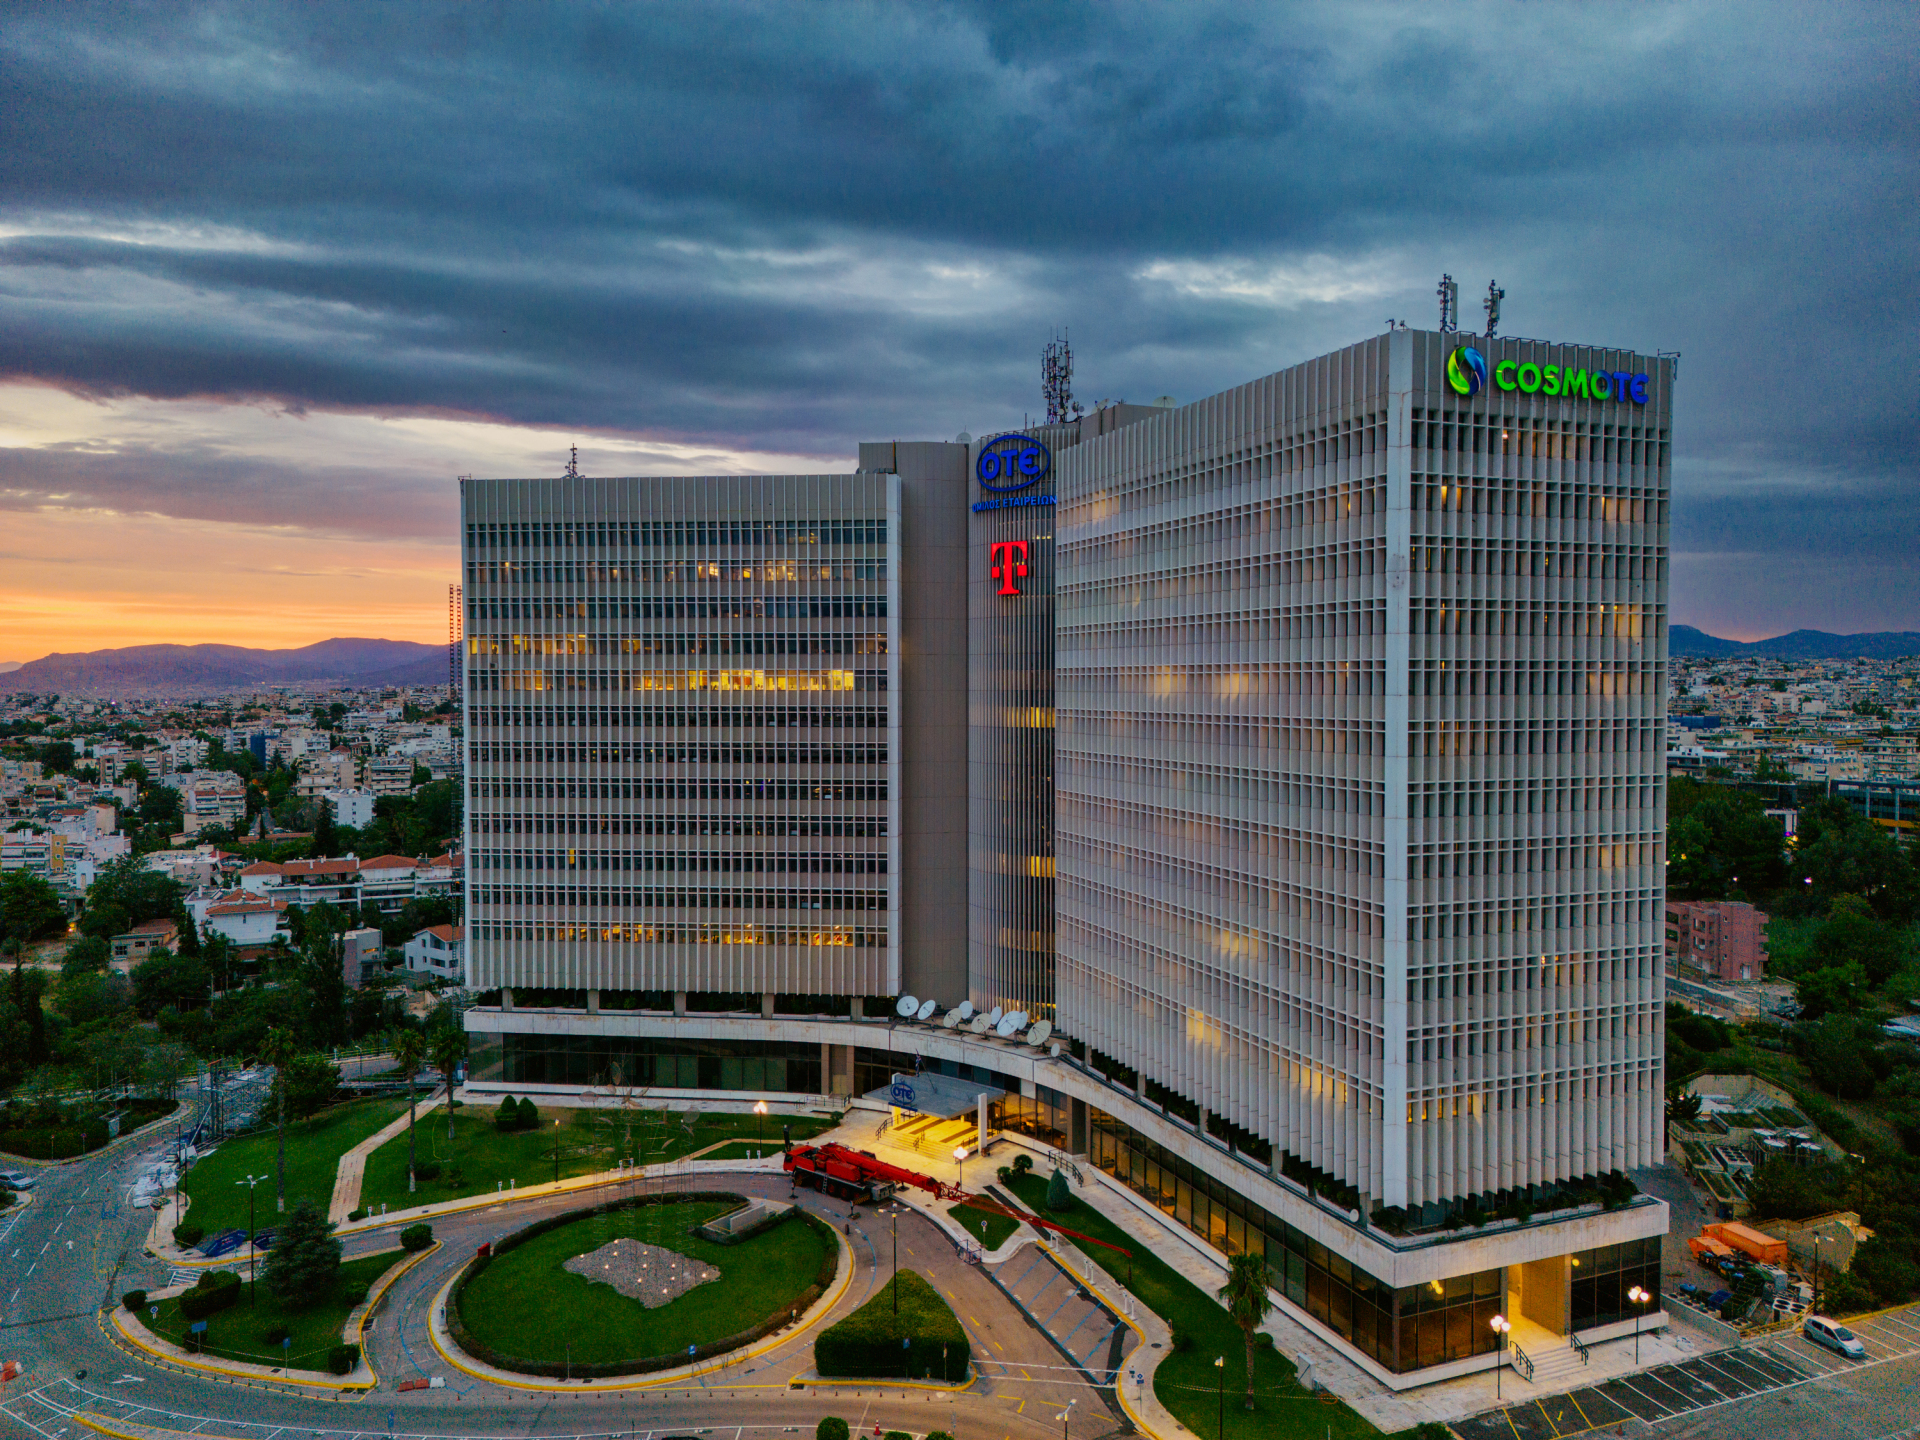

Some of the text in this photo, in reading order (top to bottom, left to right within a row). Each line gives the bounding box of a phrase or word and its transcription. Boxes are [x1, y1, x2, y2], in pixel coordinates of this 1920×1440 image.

[1495, 359, 1649, 404] COSMOTE
[981, 447, 1040, 480] OTE
[972, 495, 1057, 513] ΟΜΙΛΟΣ ΕΤΑΙΡΕΙΩΝ
[991, 541, 1028, 595] T
